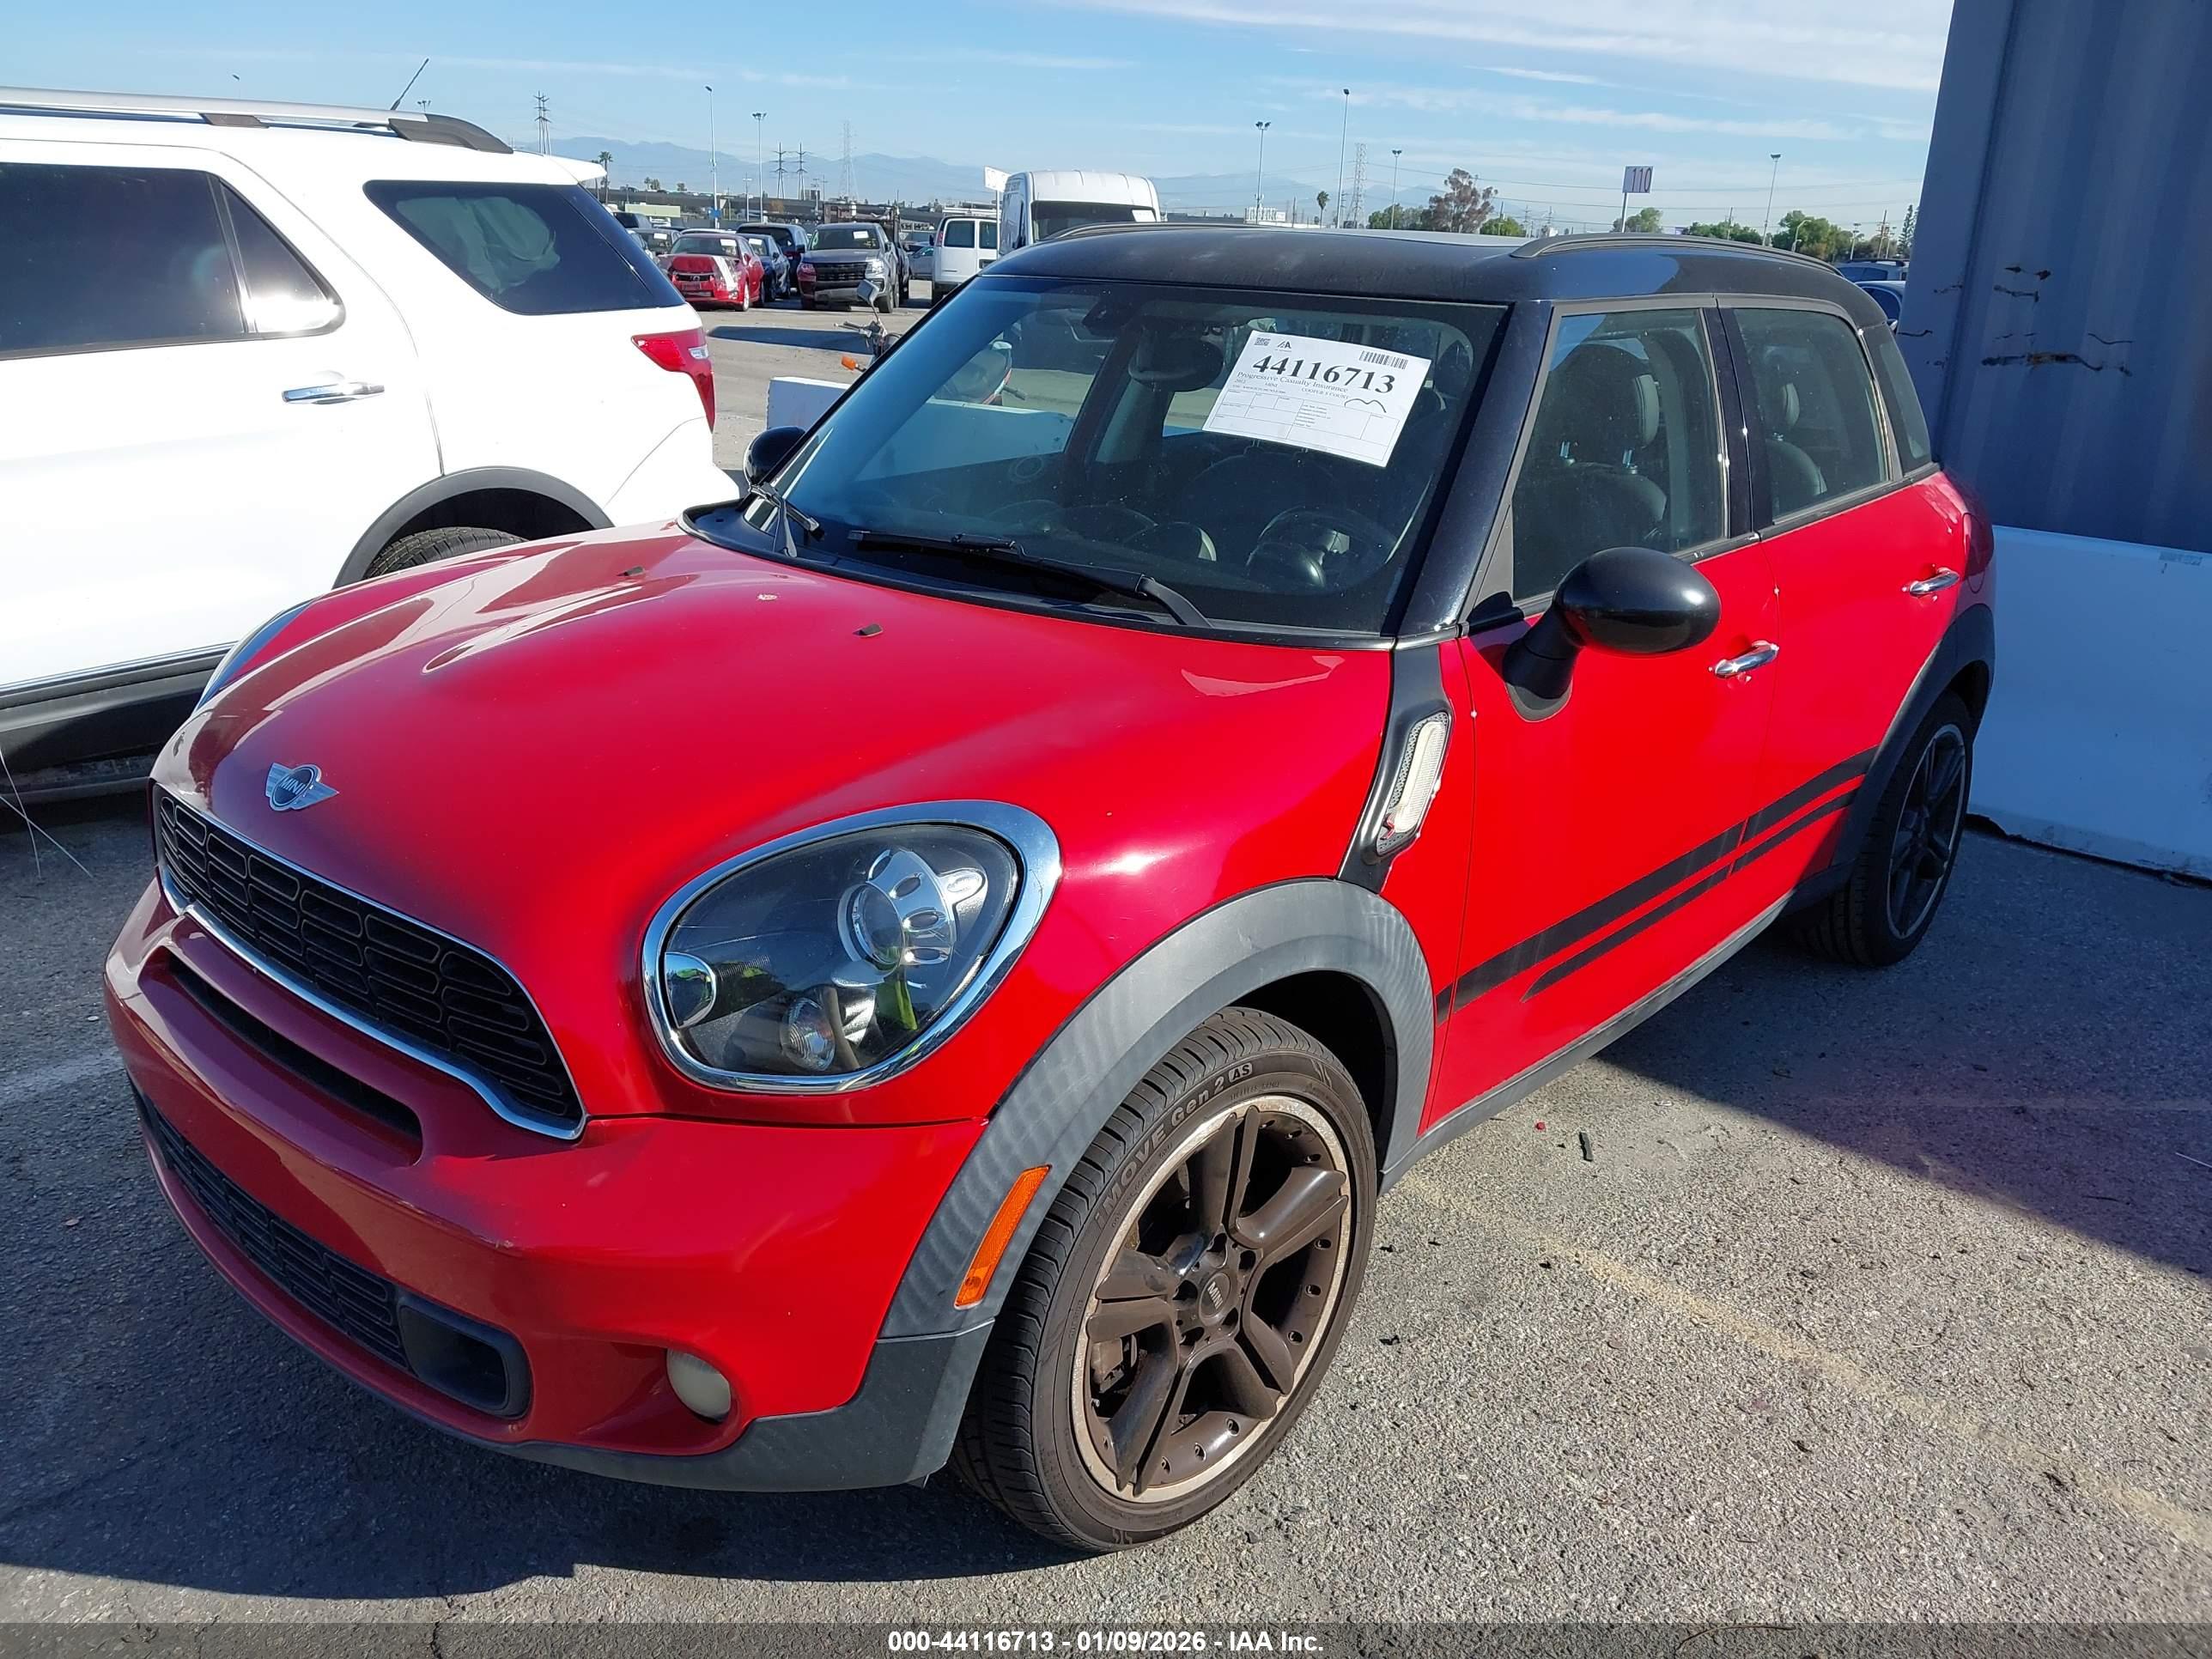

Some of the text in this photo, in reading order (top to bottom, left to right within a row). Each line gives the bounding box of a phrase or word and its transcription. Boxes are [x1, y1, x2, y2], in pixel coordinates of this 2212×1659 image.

[1632, 167, 1652, 193] 110
[1237, 371, 1348, 393] Progressive Casualty Insurance
[1252, 355, 1395, 394] 44116713
[278, 775, 307, 795] MINI
[1170, 1089, 1211, 1127] Gen
[1213, 1076, 1225, 1095] 2
[1231, 1064, 1250, 1081] AS
[1206, 1280, 1224, 1310] MINI
